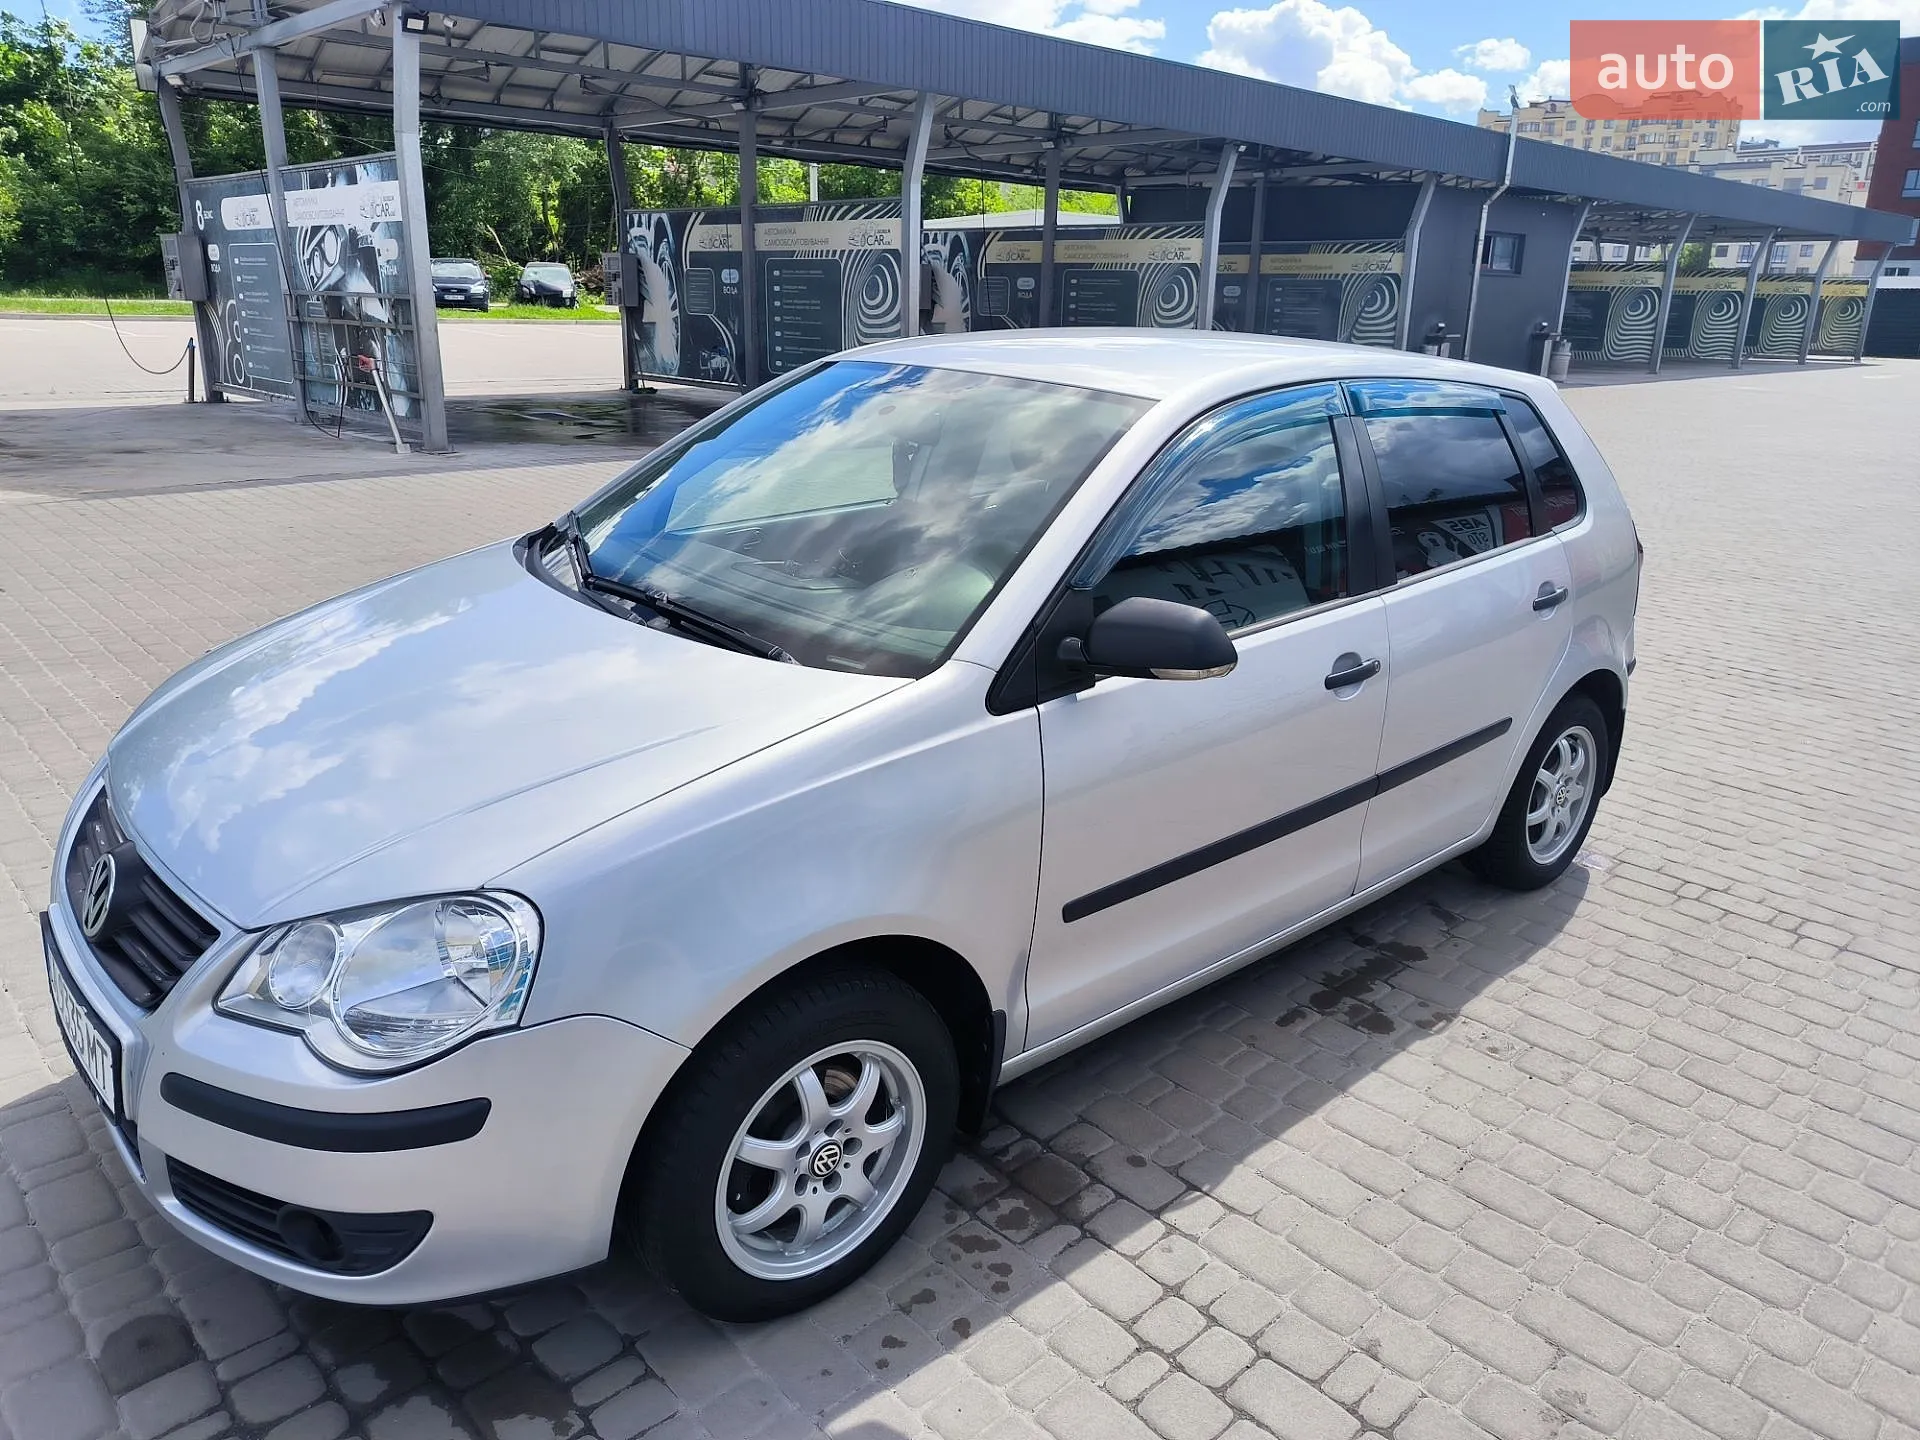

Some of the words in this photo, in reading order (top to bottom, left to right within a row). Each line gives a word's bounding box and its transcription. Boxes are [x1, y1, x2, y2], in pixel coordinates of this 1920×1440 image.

[195, 199, 205, 231] 8
[374, 203, 391, 218] CAR
[866, 234, 885, 246] CAR
[1167, 251, 1185, 261] CAR
